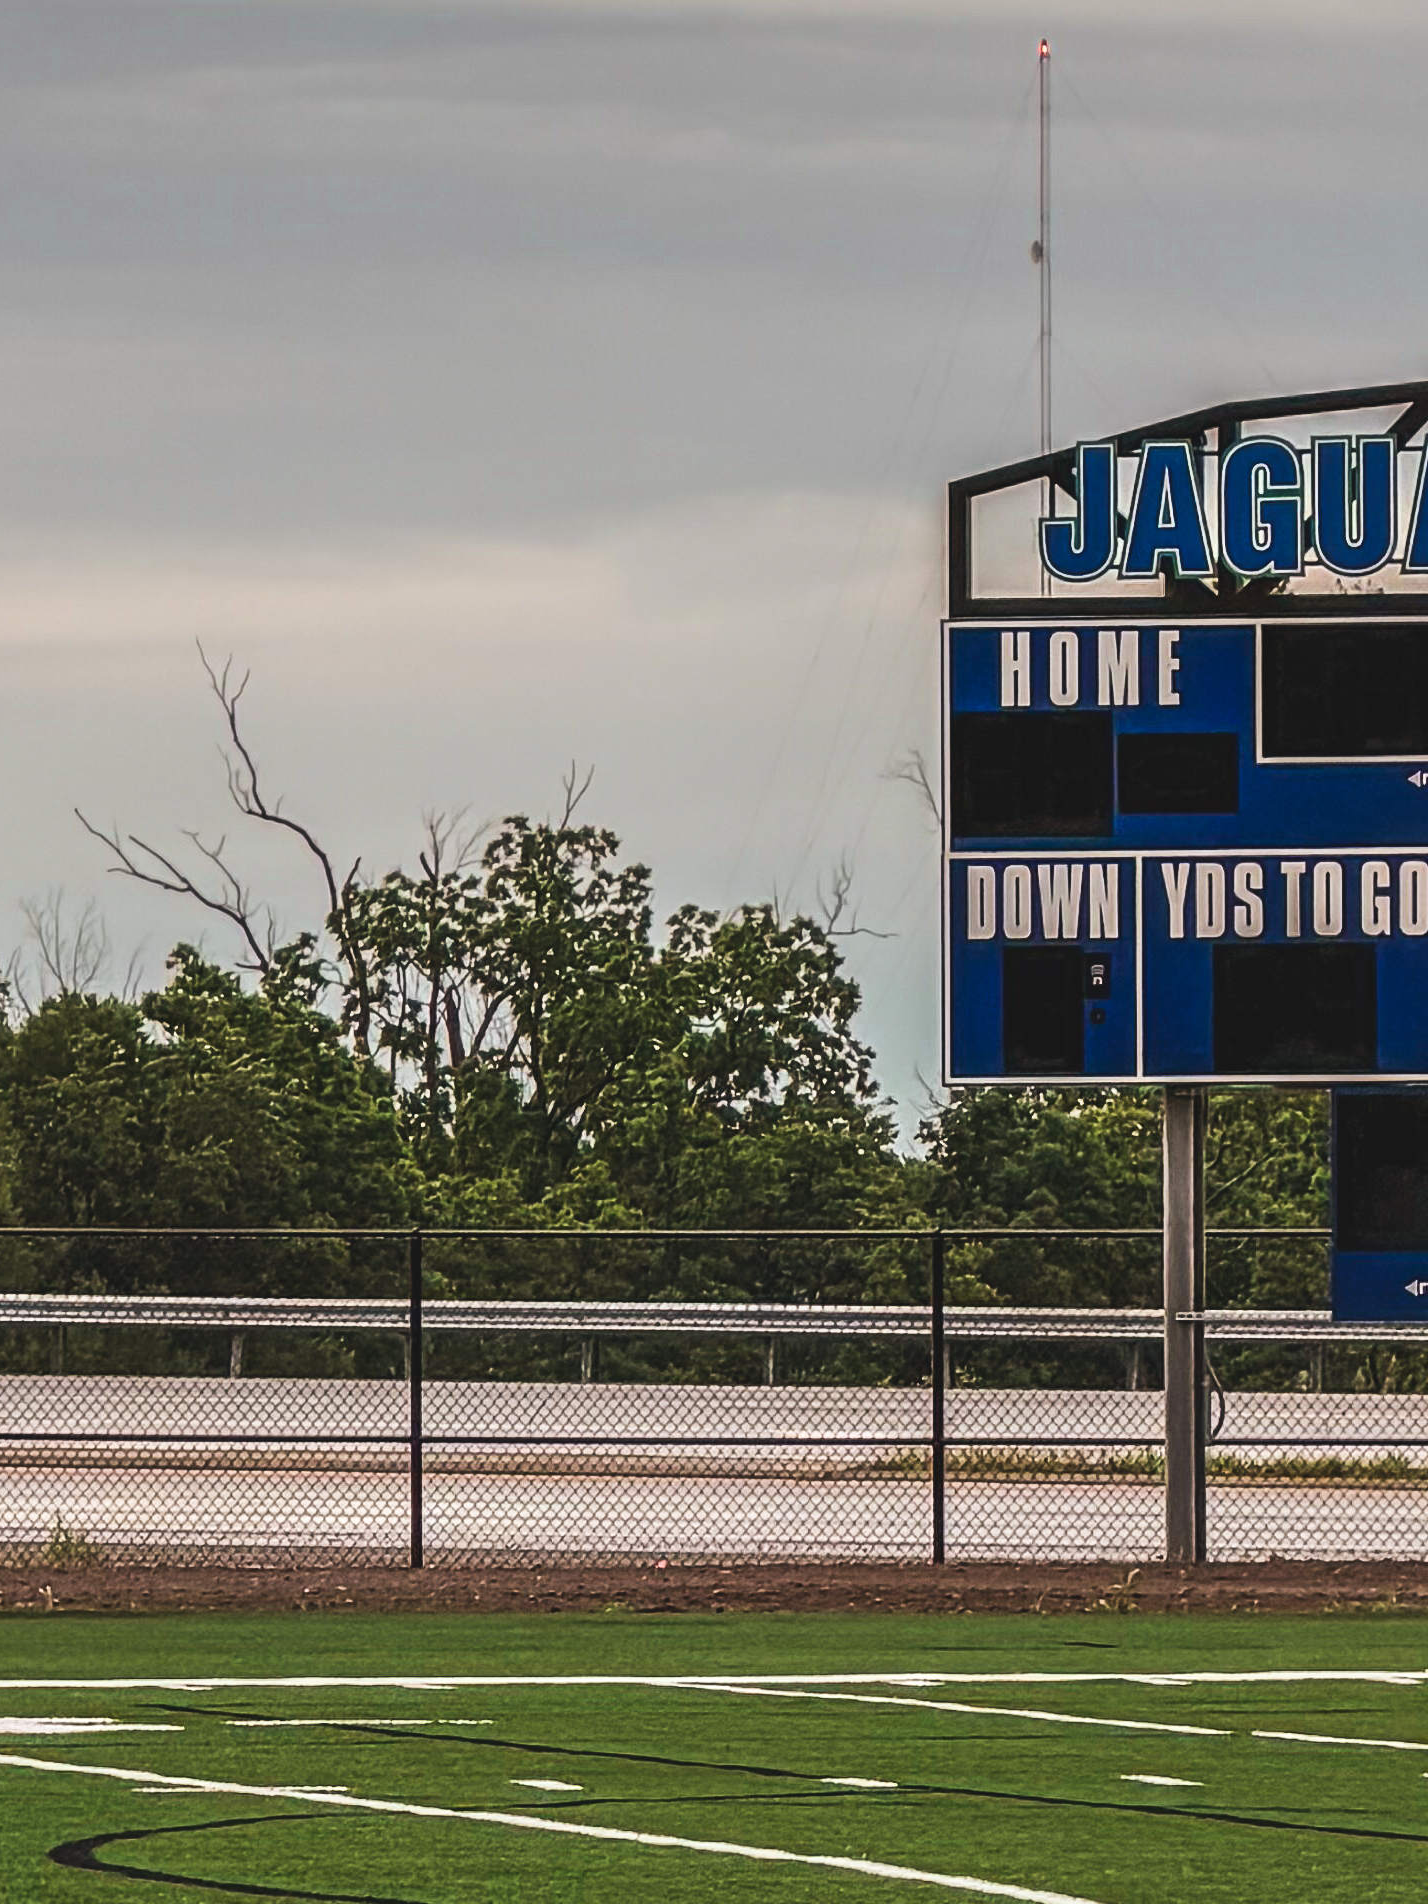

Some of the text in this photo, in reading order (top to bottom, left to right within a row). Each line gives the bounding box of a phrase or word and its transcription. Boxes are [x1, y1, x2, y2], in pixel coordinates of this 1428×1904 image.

[1000, 630, 1181, 707] HOME
[966, 862, 1119, 940] DOWN
[1160, 862, 1264, 939] YDS
[1280, 860, 1343, 937] TO
